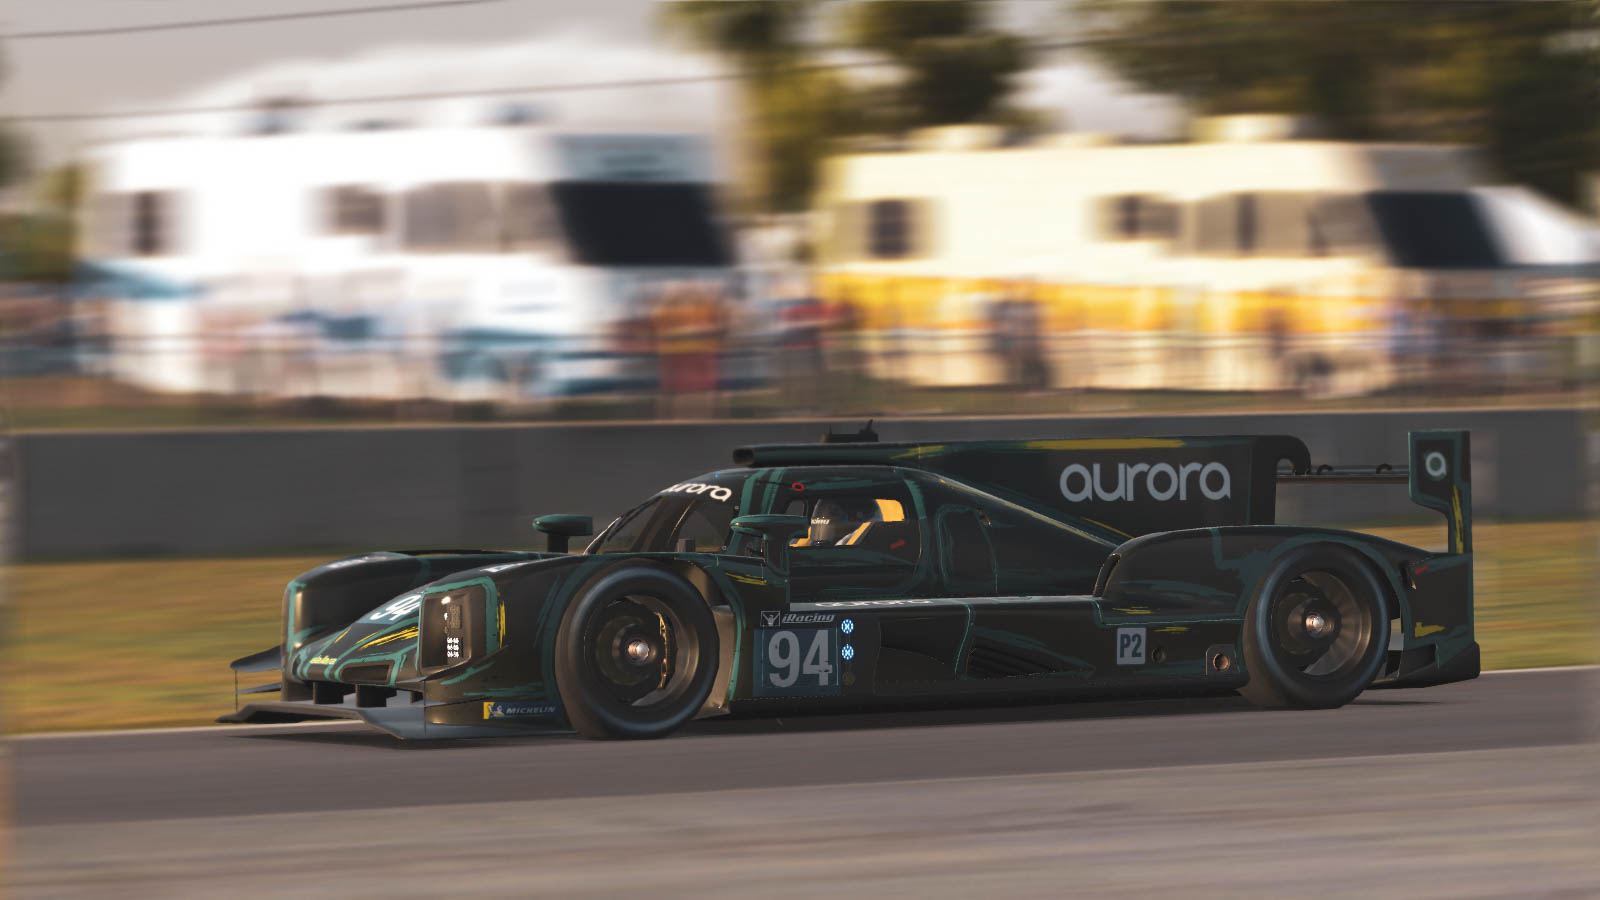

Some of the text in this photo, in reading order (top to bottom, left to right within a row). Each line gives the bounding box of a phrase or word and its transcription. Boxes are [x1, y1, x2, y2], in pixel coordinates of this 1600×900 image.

[1060, 462, 1231, 502] aurora
[782, 613, 835, 624] iRacing
[1120, 633, 1142, 658] P2
[768, 629, 833, 688] 94
[506, 706, 556, 714] MICHELIN
